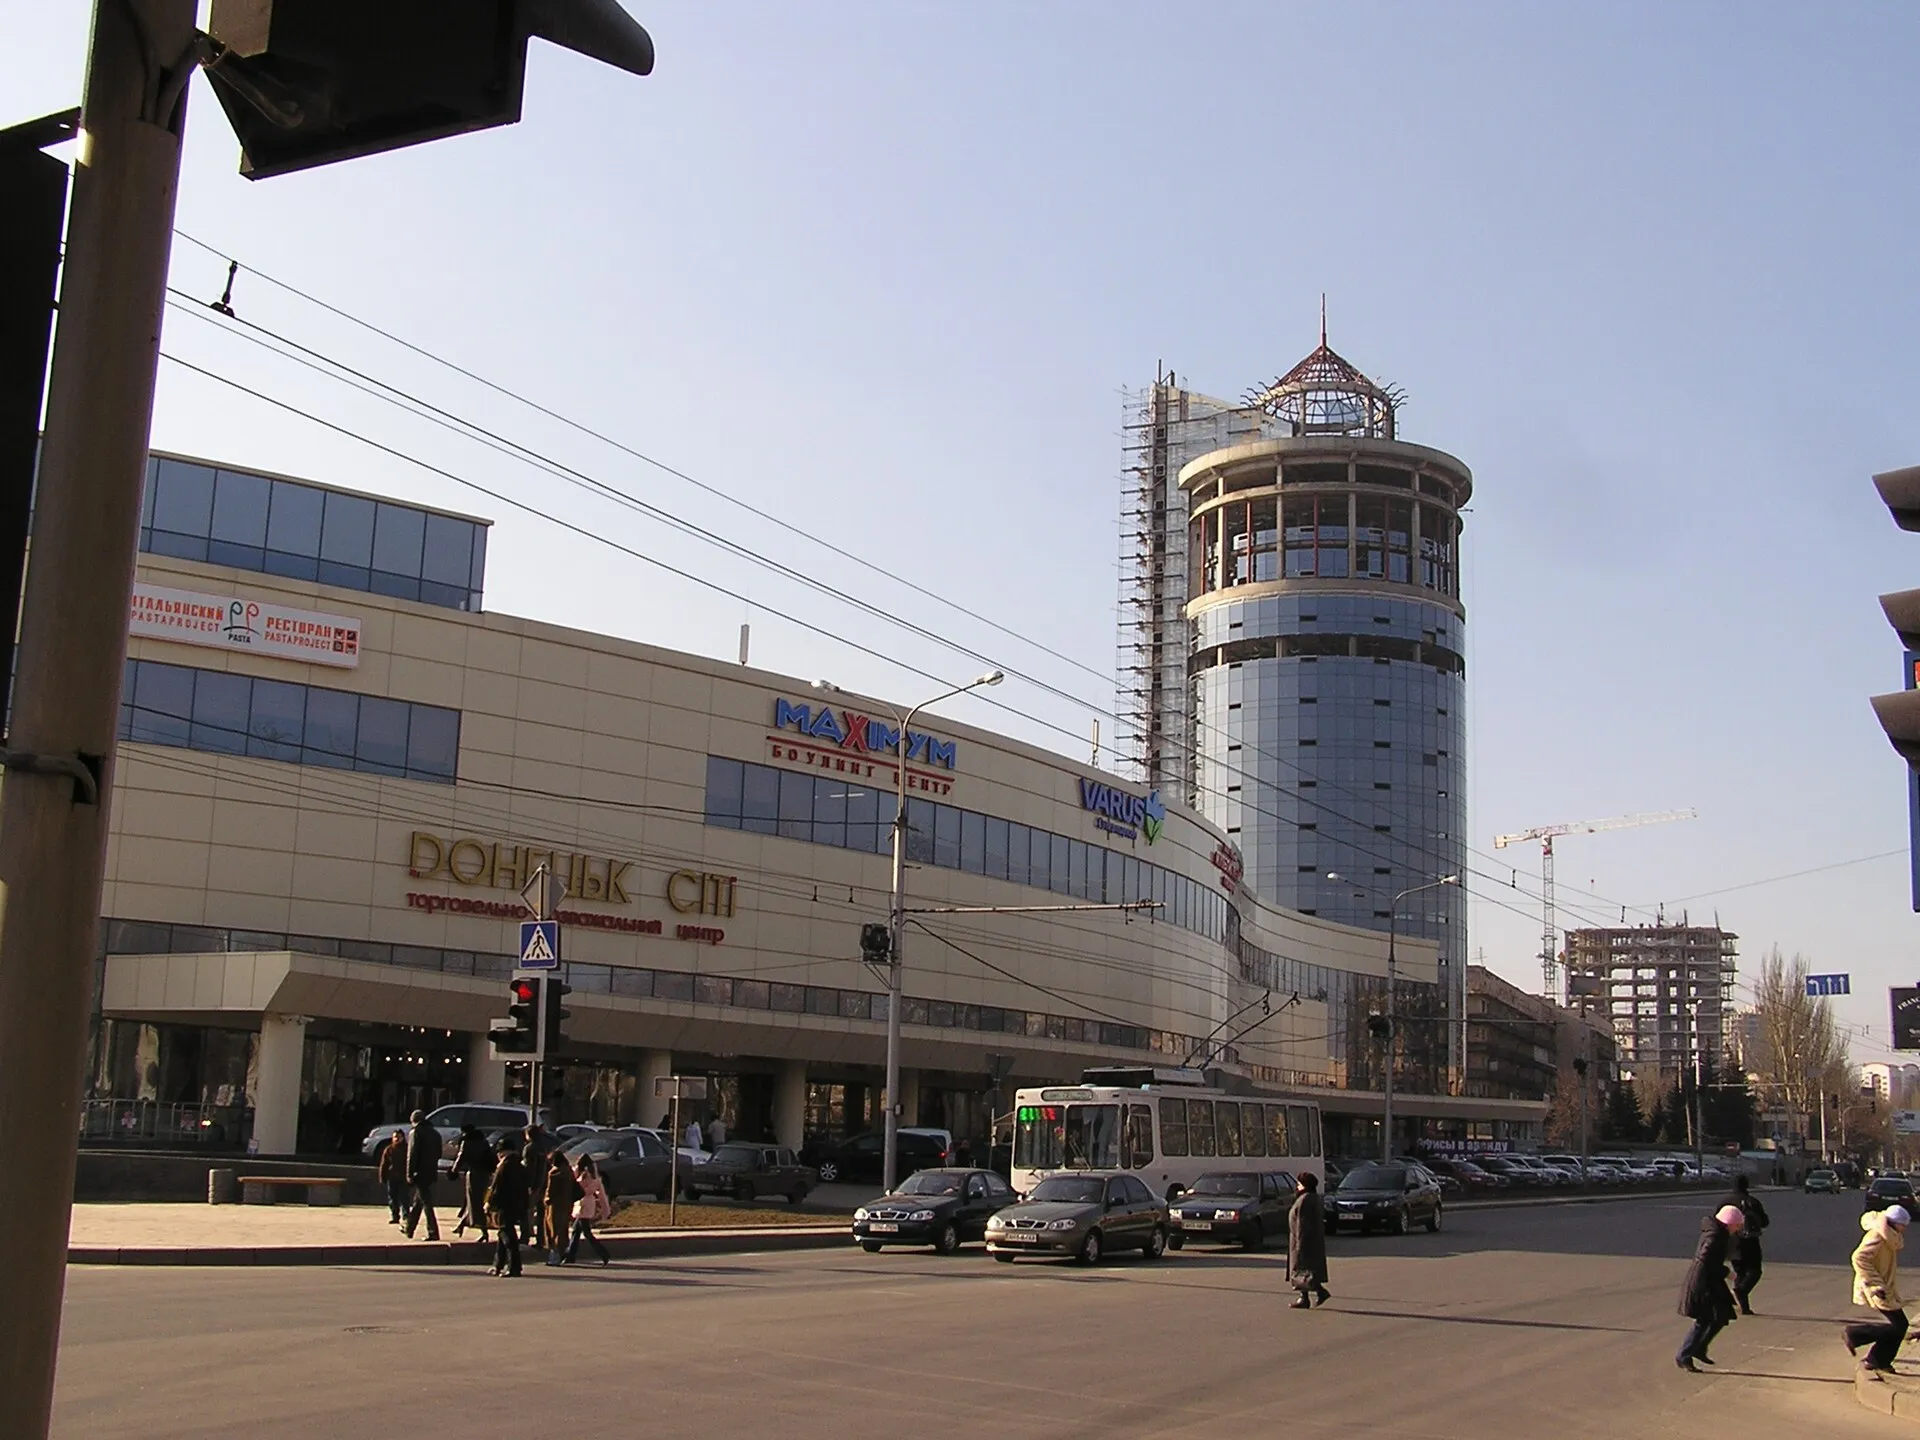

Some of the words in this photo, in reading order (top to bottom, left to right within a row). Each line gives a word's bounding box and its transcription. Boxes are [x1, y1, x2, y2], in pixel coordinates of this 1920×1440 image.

[131, 610, 221, 632] PASTAPROJECT
[228, 633, 251, 643] PASTA
[264, 631, 332, 651] PASTAPROJECT
[772, 744, 876, 778] БОУЛИНГ
[1081, 777, 1145, 830] VARUS
[676, 924, 725, 945] центр
